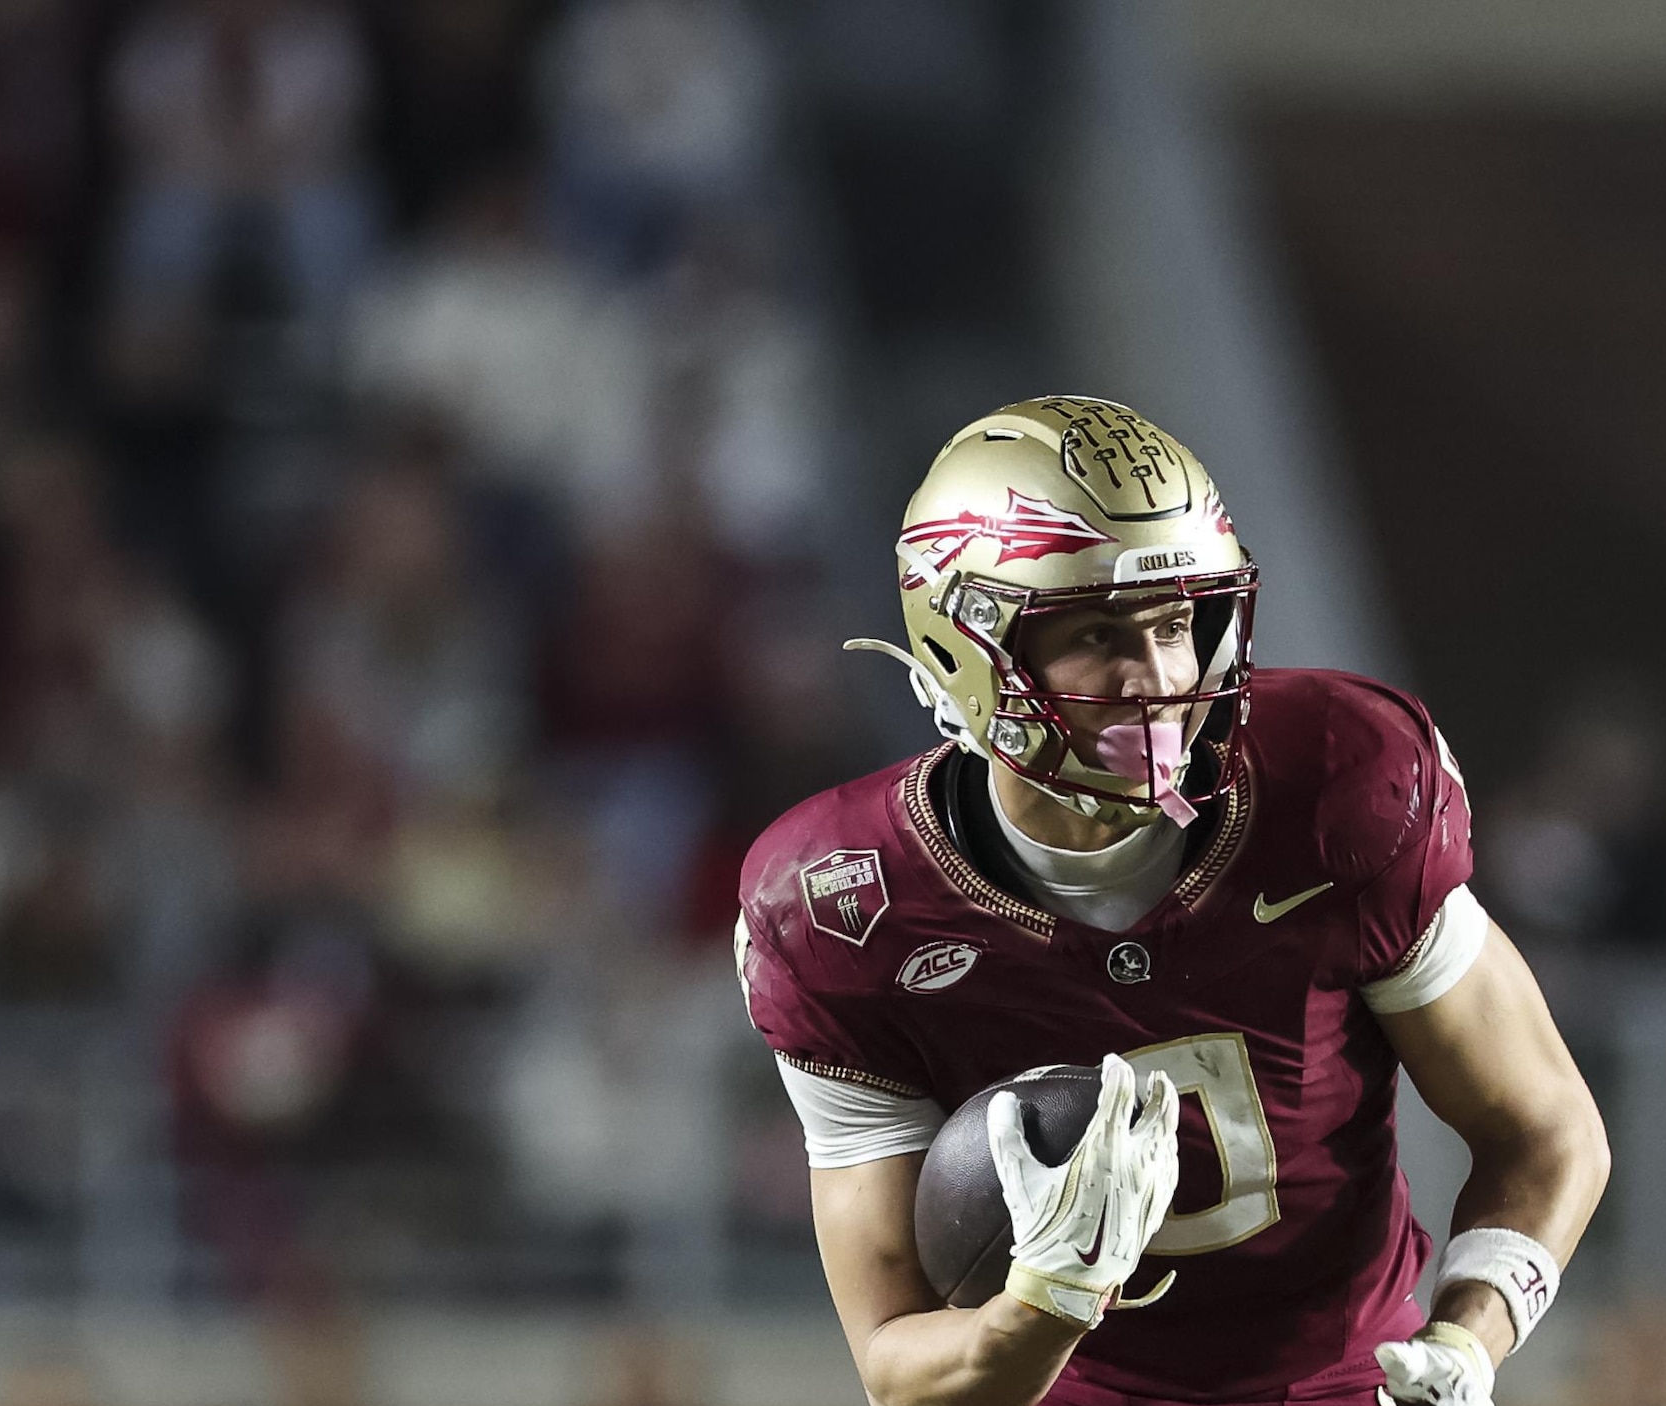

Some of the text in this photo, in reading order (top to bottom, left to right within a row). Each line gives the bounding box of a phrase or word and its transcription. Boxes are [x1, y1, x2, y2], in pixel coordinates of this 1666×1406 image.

[1137, 551, 1196, 572] NOLES
[811, 871, 875, 899] SCHOLAR
[910, 947, 968, 981] ACC
[1510, 1260, 1547, 1321] 35
